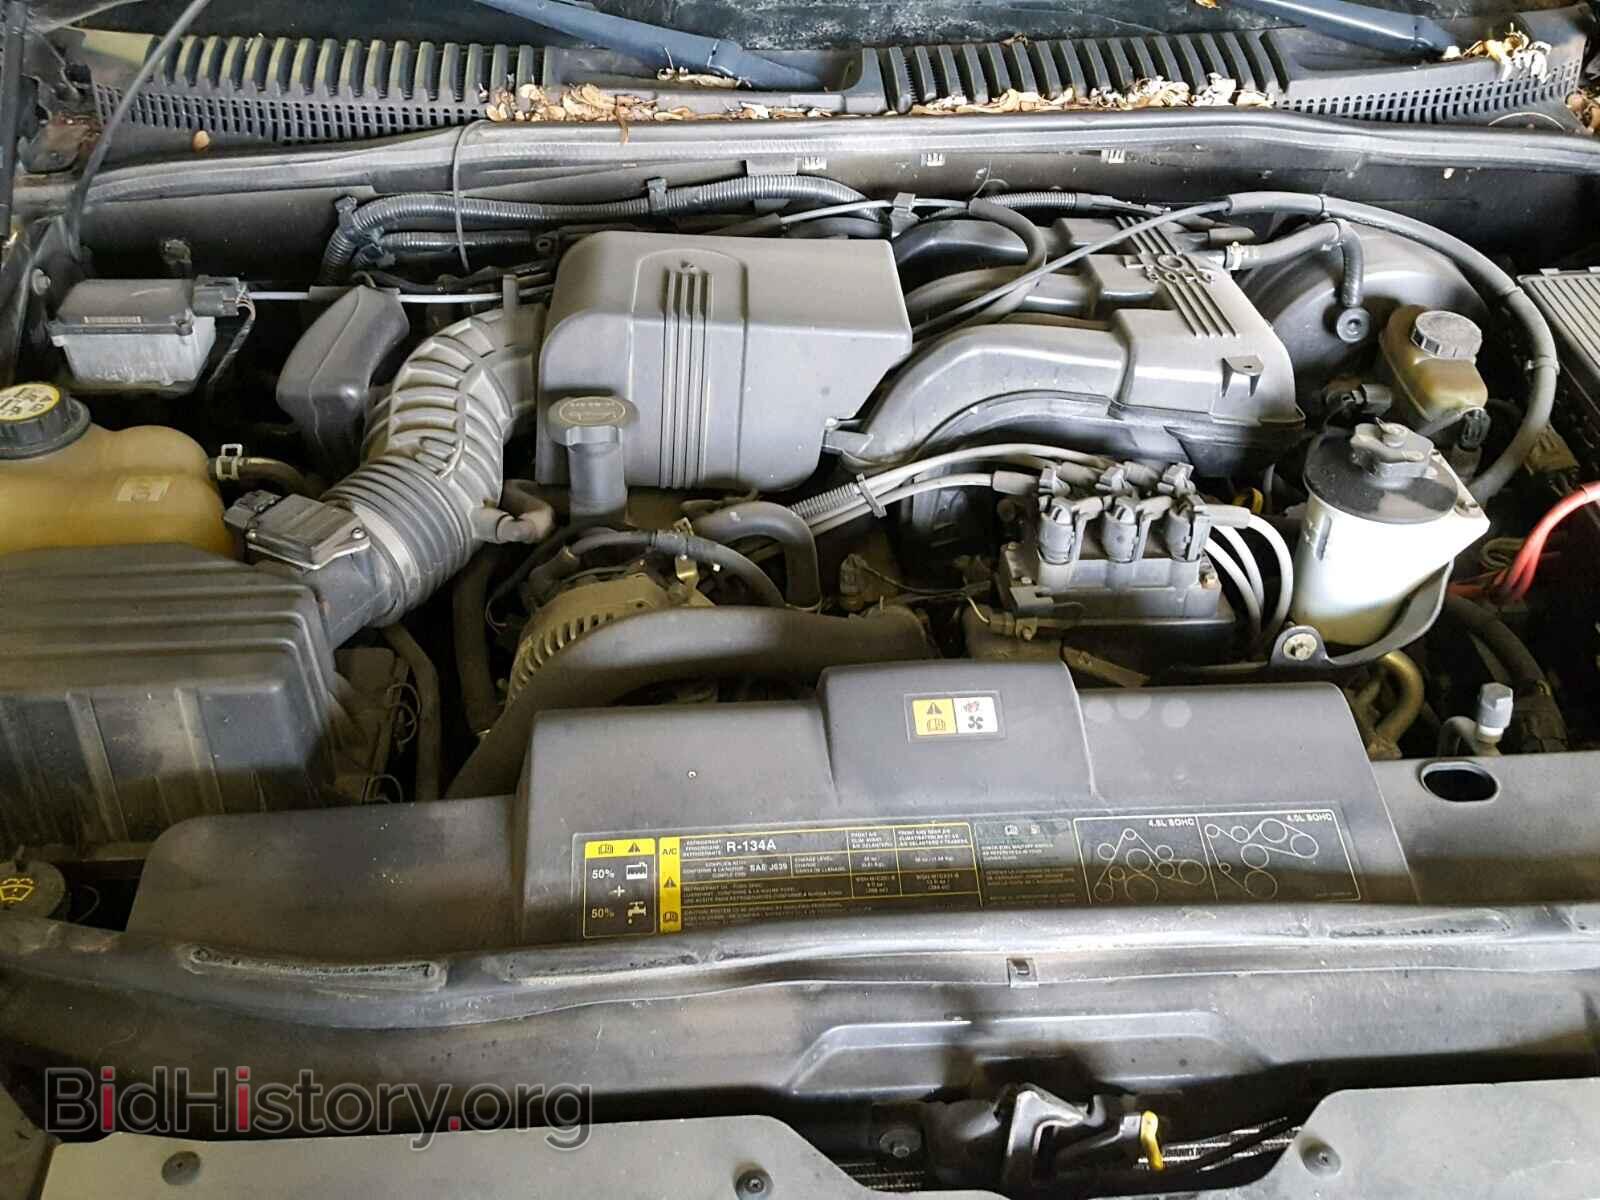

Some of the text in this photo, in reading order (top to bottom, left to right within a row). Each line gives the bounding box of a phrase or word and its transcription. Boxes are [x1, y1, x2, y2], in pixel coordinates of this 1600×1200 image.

[1168, 817, 1195, 828] SOHC
[1307, 812, 1333, 823] SOHC
[726, 839, 777, 853] R-134A
[662, 848, 677, 856] A/C
[750, 864, 766, 873] SAE
[769, 863, 788, 872] J639
[591, 868, 615, 880] 50%
[591, 907, 615, 919] 50%
